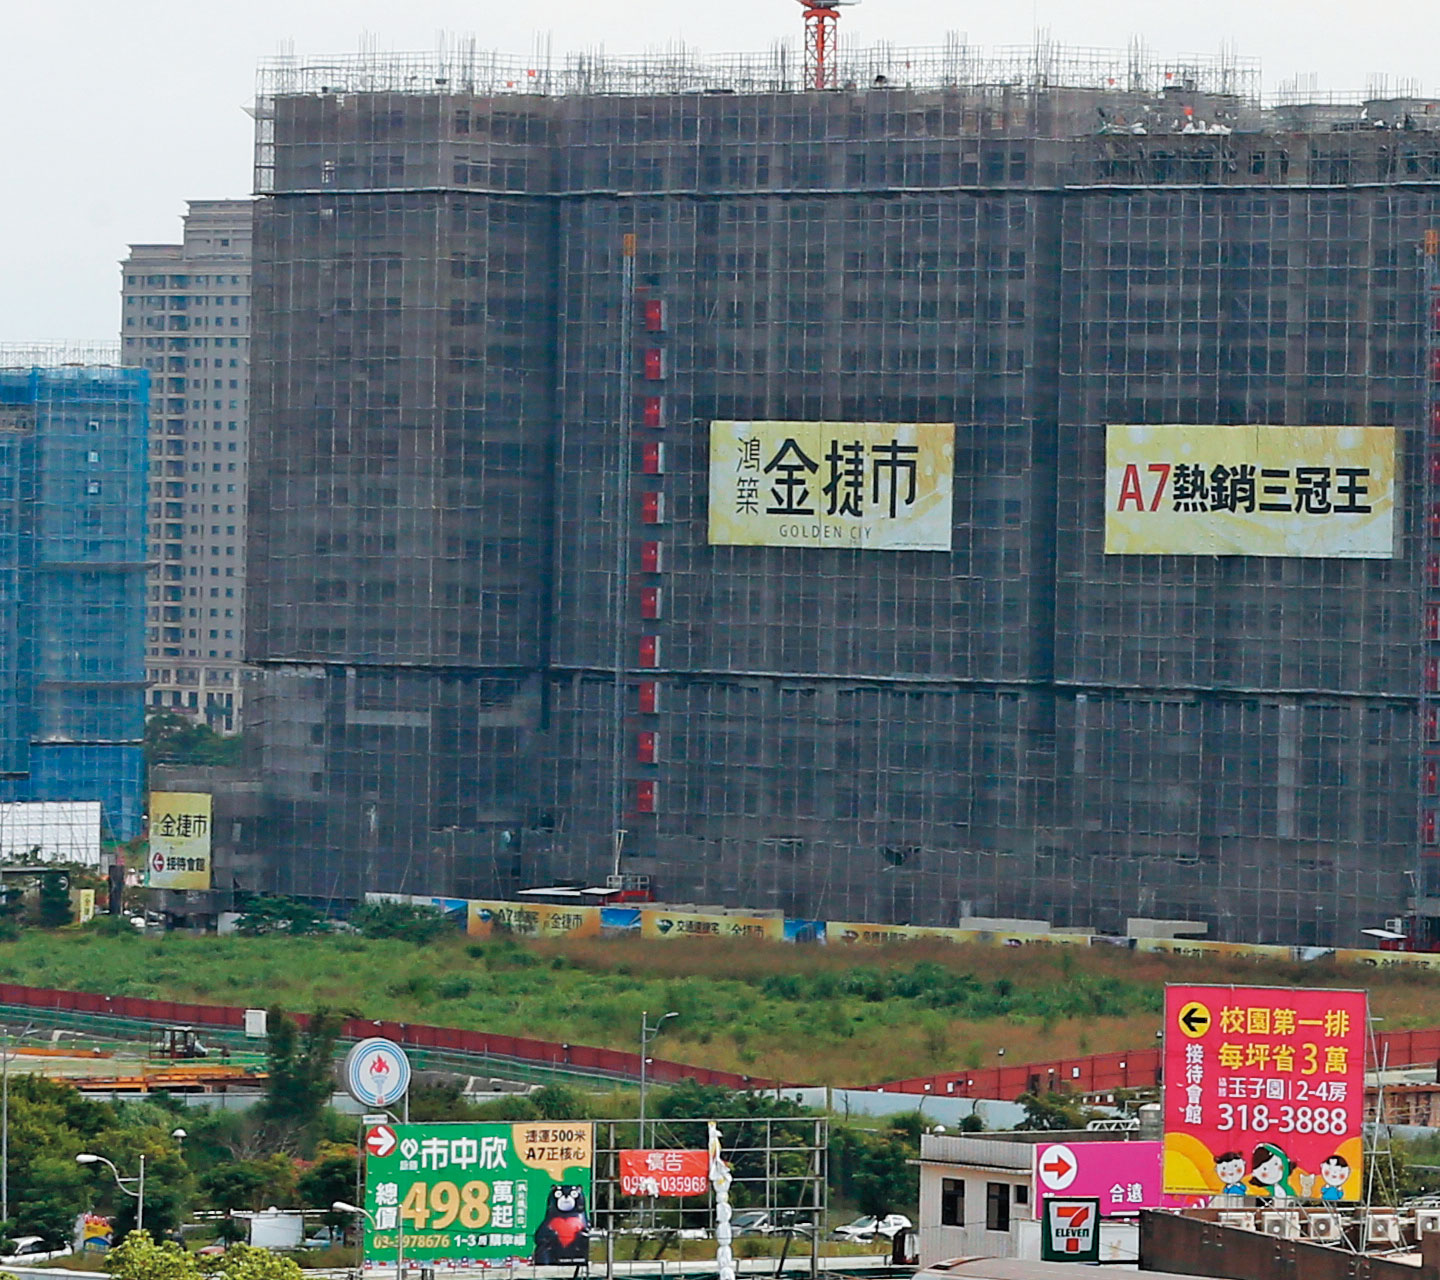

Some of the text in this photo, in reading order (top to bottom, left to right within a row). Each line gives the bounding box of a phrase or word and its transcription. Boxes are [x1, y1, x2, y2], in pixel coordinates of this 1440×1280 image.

[736, 436, 761, 516] 鴻築
[763, 438, 920, 519] 金捷市
[1116, 463, 1372, 514] A7熱銷三冠王
[778, 524, 842, 539] GOLDEN
[160, 813, 208, 839] 金捷市
[1219, 1006, 1351, 1038] 校園第一排
[1218, 1041, 1349, 1075] 每坪省3萬
[1184, 1042, 1204, 1125] 接待會館
[1228, 1076, 1285, 1101] 玉子園
[1295, 1080, 1348, 1103] 2-4房
[1216, 1103, 1348, 1136] 318-3888
[647, 1153, 683, 1172] 廣告
[374, 1181, 399, 1231] 總價
[400, 1179, 491, 1230] 498
[490, 1180, 514, 1229] 萬起
[1055, 1227, 1090, 1239] ELEVEN
